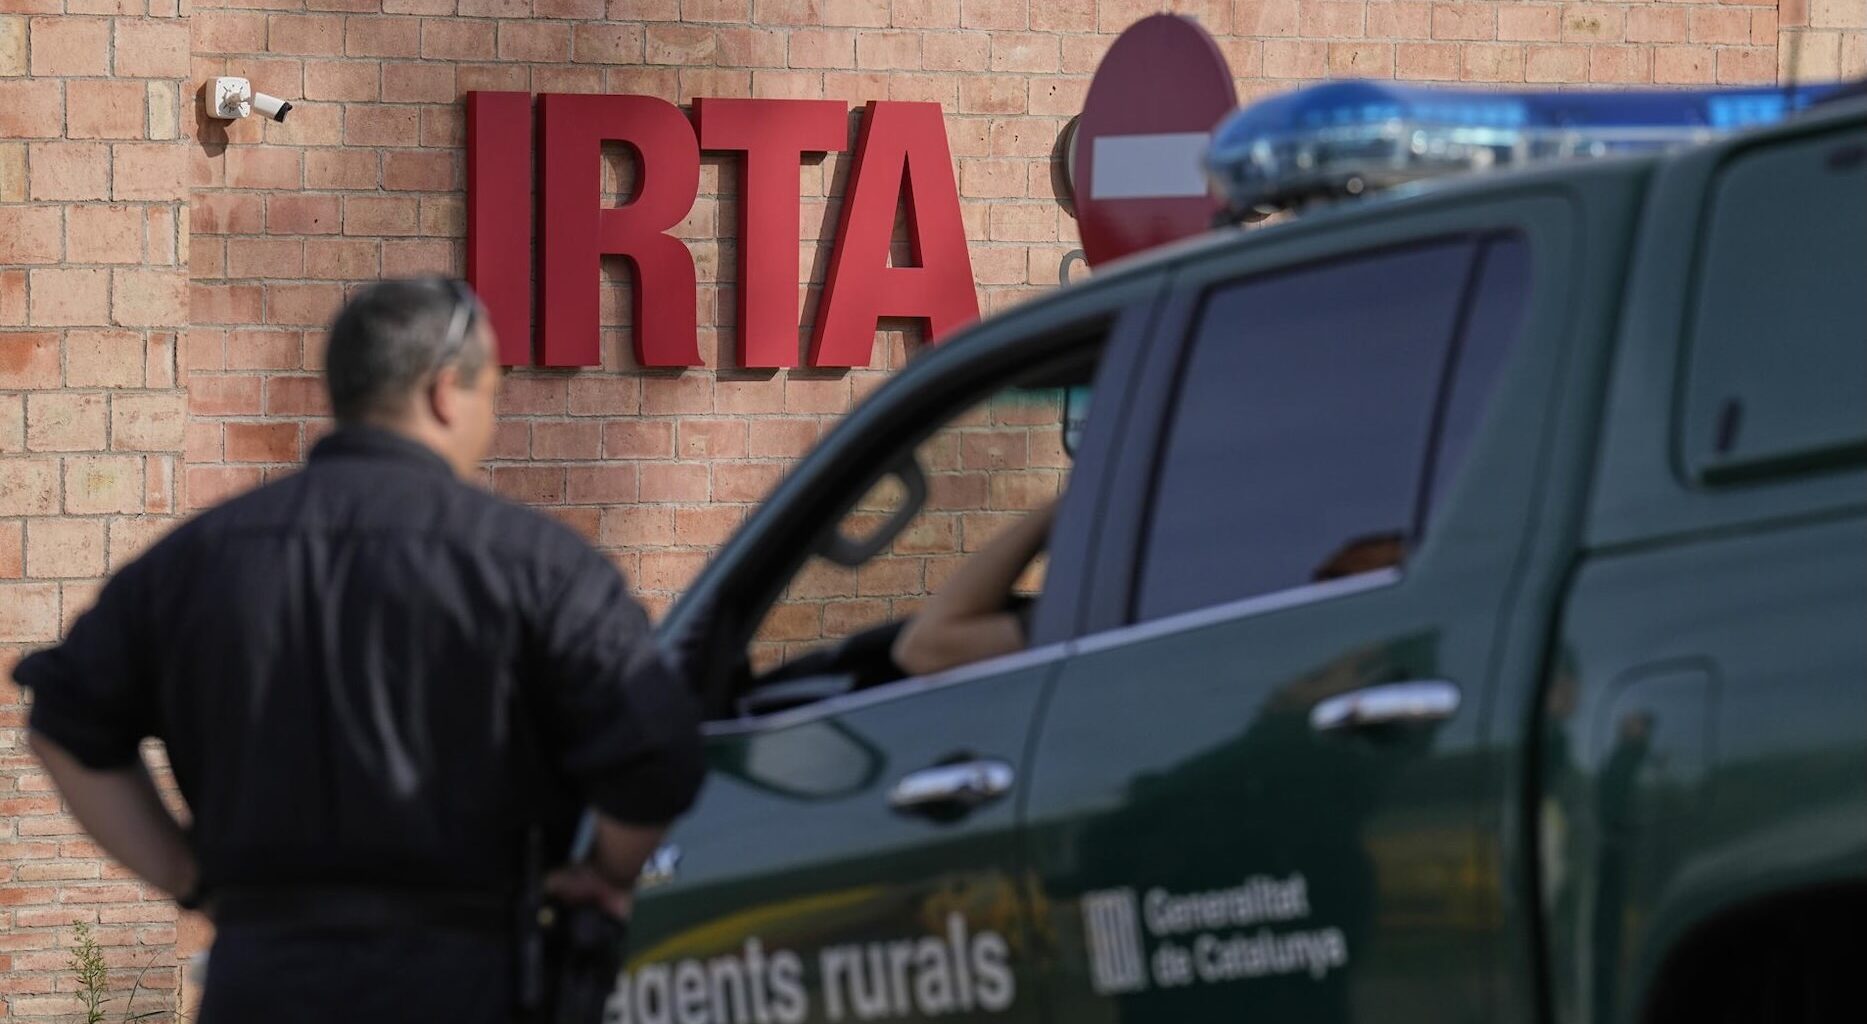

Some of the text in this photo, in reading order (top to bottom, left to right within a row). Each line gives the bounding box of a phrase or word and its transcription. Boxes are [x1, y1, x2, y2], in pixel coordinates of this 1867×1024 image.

[467, 91, 979, 368] IRTA
[1144, 871, 1308, 934] Generalitat
[821, 911, 1014, 1020] rurals
[1155, 927, 1348, 986] de Catalunya
